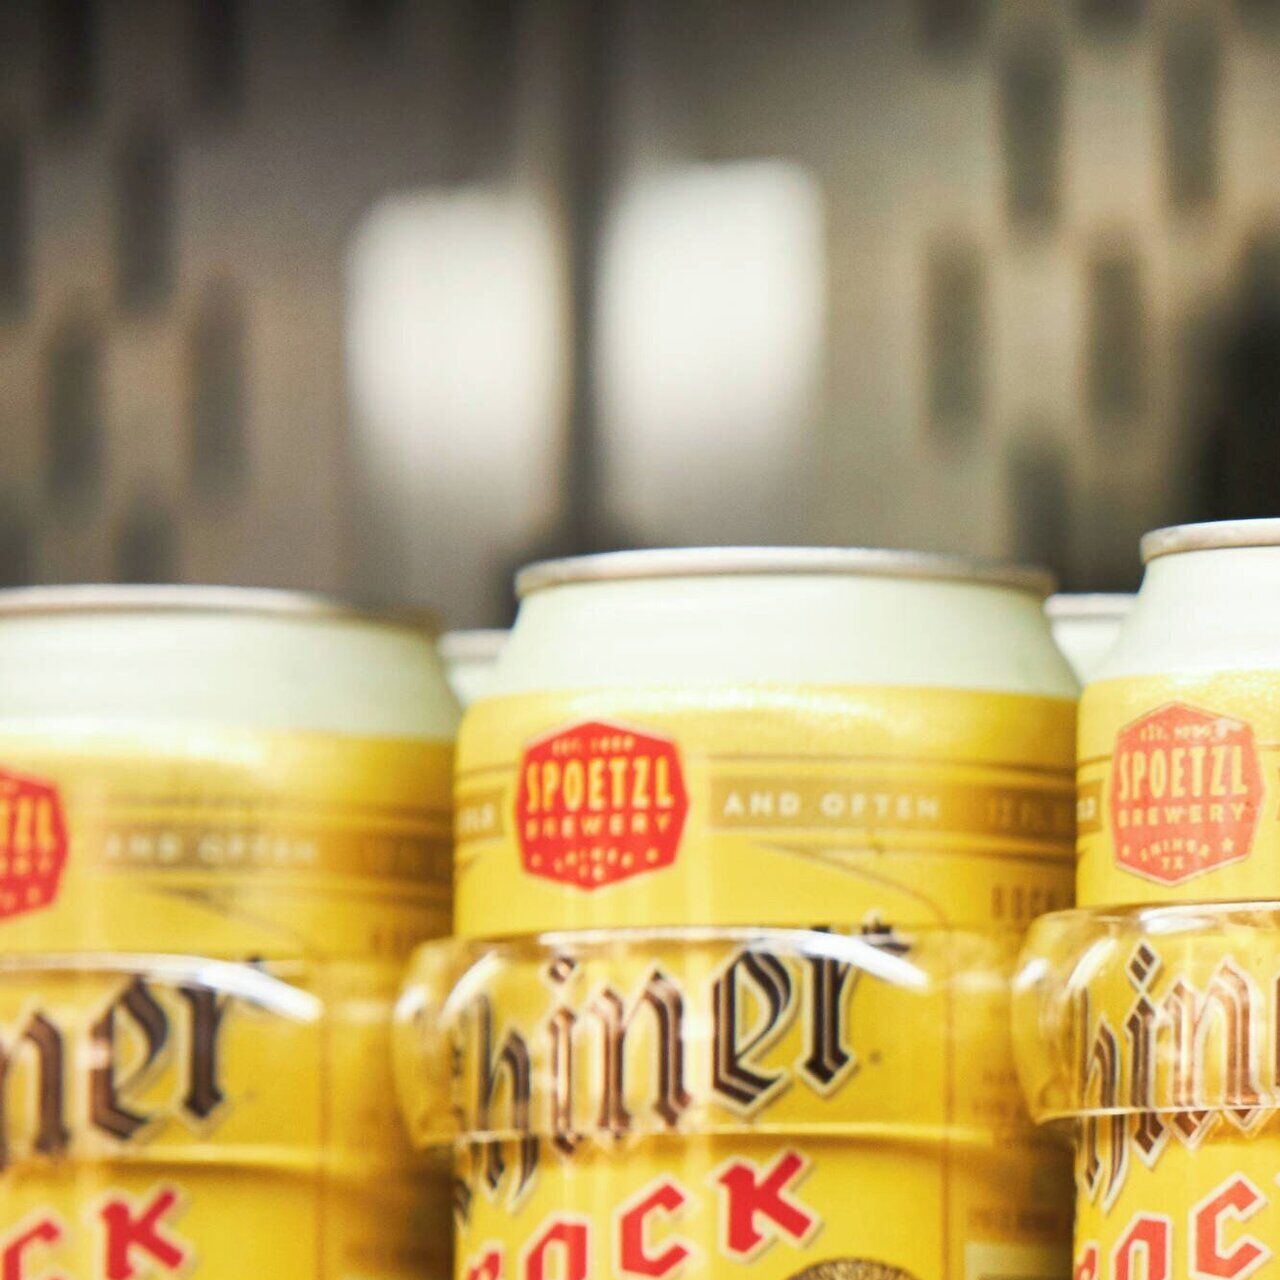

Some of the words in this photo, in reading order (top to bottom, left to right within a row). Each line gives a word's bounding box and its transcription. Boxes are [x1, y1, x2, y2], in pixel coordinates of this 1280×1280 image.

[526, 754, 675, 814] SPOETZL
[1119, 745, 1248, 803] SPOETZL
[722, 791, 799, 818] AND
[821, 791, 939, 820] OFTEN
[1118, 802, 1246, 828] BREWERY
